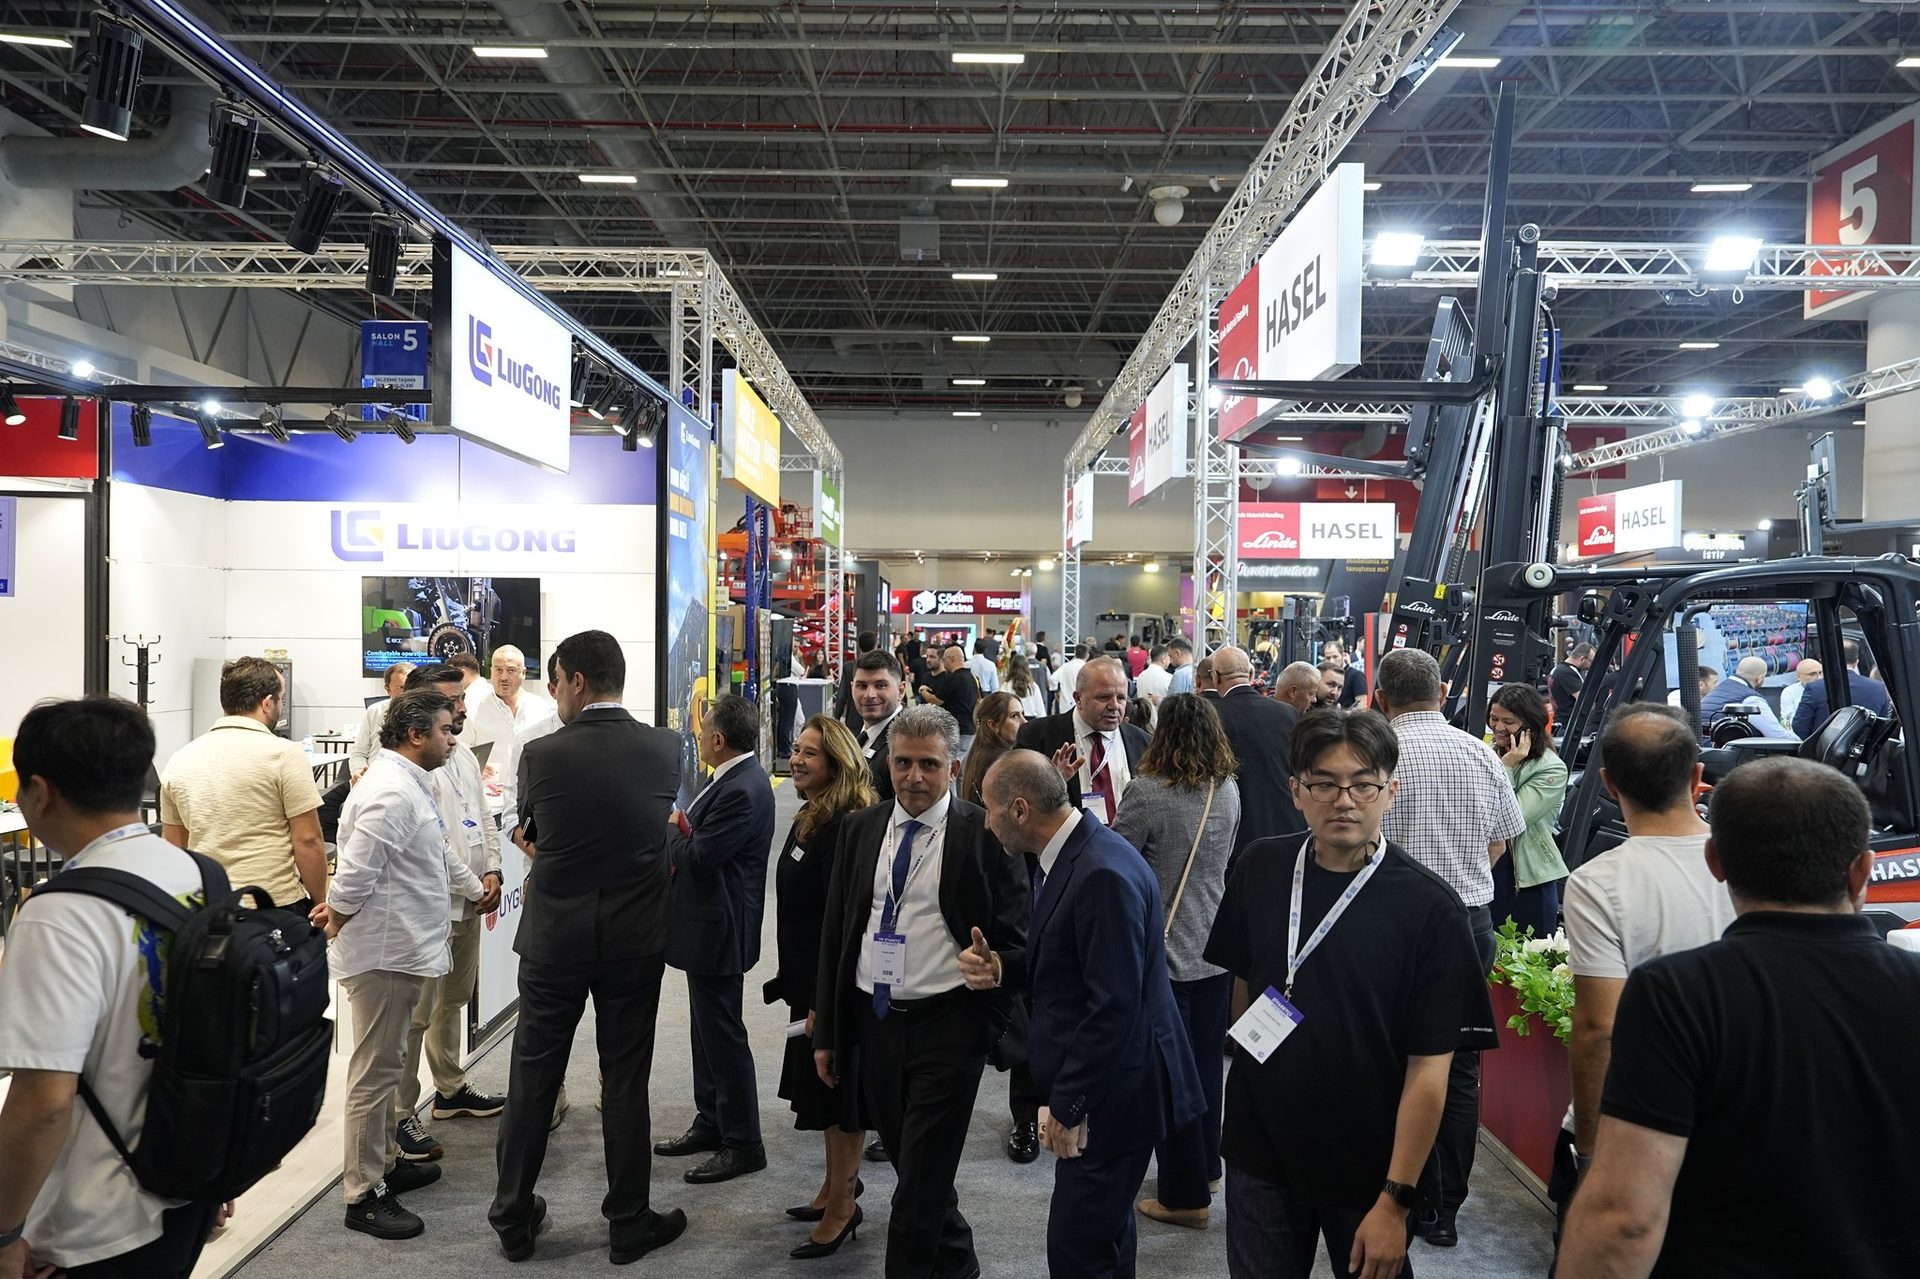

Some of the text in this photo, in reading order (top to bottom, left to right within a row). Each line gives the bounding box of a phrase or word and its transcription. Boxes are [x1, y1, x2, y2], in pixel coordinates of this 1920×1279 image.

[1838, 154, 1879, 248] 5
[1265, 253, 1327, 354] HASEL
[403, 328, 419, 352] 5
[1147, 409, 1170, 459] HASEL
[1621, 506, 1667, 530] HASEL
[1242, 530, 1298, 550] Linde
[1311, 522, 1384, 540] HASEL
[1400, 600, 1436, 615] Linde
[1484, 610, 1520, 622] Linde
